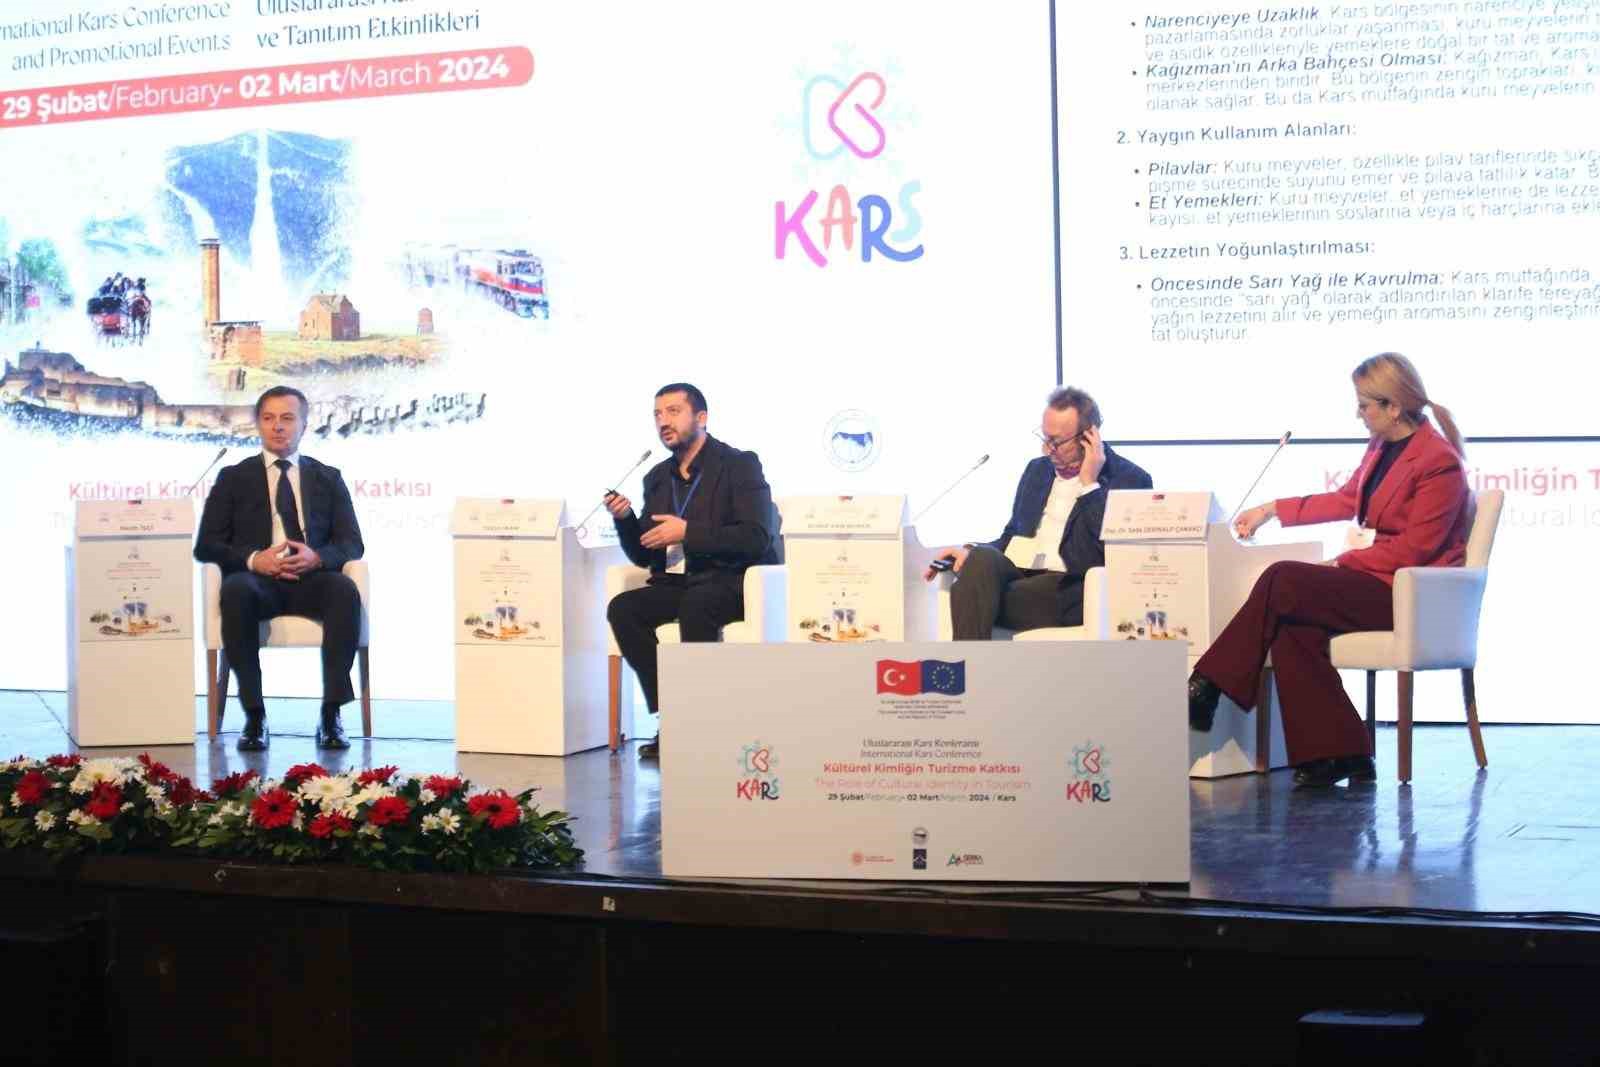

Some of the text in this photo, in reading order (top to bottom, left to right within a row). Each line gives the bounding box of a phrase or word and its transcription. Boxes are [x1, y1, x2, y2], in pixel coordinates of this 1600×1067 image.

[79, 9, 118, 32] Kars
[123, 1, 231, 28] Conference
[1330, 5, 1368, 18] Kars
[257, 9, 480, 48] ve Tanıtım Etkinlikleri
[12, 33, 232, 71] and Promotional Events
[1145, 48, 1164, 62] ve
[1257, 58, 1297, 71] Arka
[1551, 46, 1590, 60] Kars
[3, 97, 31, 119] 29
[239, 75, 272, 98] 02
[278, 62, 431, 96] Mart/March
[439, 55, 510, 82] 2024
[1332, 71, 1353, 85] Bu
[1265, 91, 1287, 106] Bu
[1292, 90, 1312, 105] da
[1319, 88, 1357, 103] Kars
[1117, 121, 1357, 147] 2. Yaygın Kullanım Alanları:
[1149, 160, 1217, 176] Pilavlar:
[1224, 160, 1261, 174] Kuru
[1351, 172, 1393, 186] emer
[1400, 171, 1419, 185] ve
[1149, 195, 1167, 210] Et
[1173, 192, 1264, 209] Yemekleri:
[1270, 191, 1308, 206] Kuru
[775, 180, 924, 268] KARS
[1120, 245, 1134, 260] 3.
[1216, 239, 1376, 261] Yoğunlaştırılması:
[1249, 274, 1284, 289] Sarı
[1290, 272, 1322, 292] Yağ
[1328, 272, 1348, 287] ile
[1354, 270, 1445, 286] Kavrulma:
[1451, 269, 1489, 284] Kars
[1303, 309, 1322, 321] ve
[355, 479, 432, 498] Katkısı
[914, 739, 932, 748] Kars
[915, 750, 933, 759] Kars
[824, 763, 1021, 776] Kültürel Kimliğin Turizme Katkısı
[737, 778, 779, 801] KARS
[907, 793, 918, 801] 02
[969, 793, 989, 801] 2024
[997, 793, 1016, 801] Kars
[1067, 780, 1111, 803] KARS
